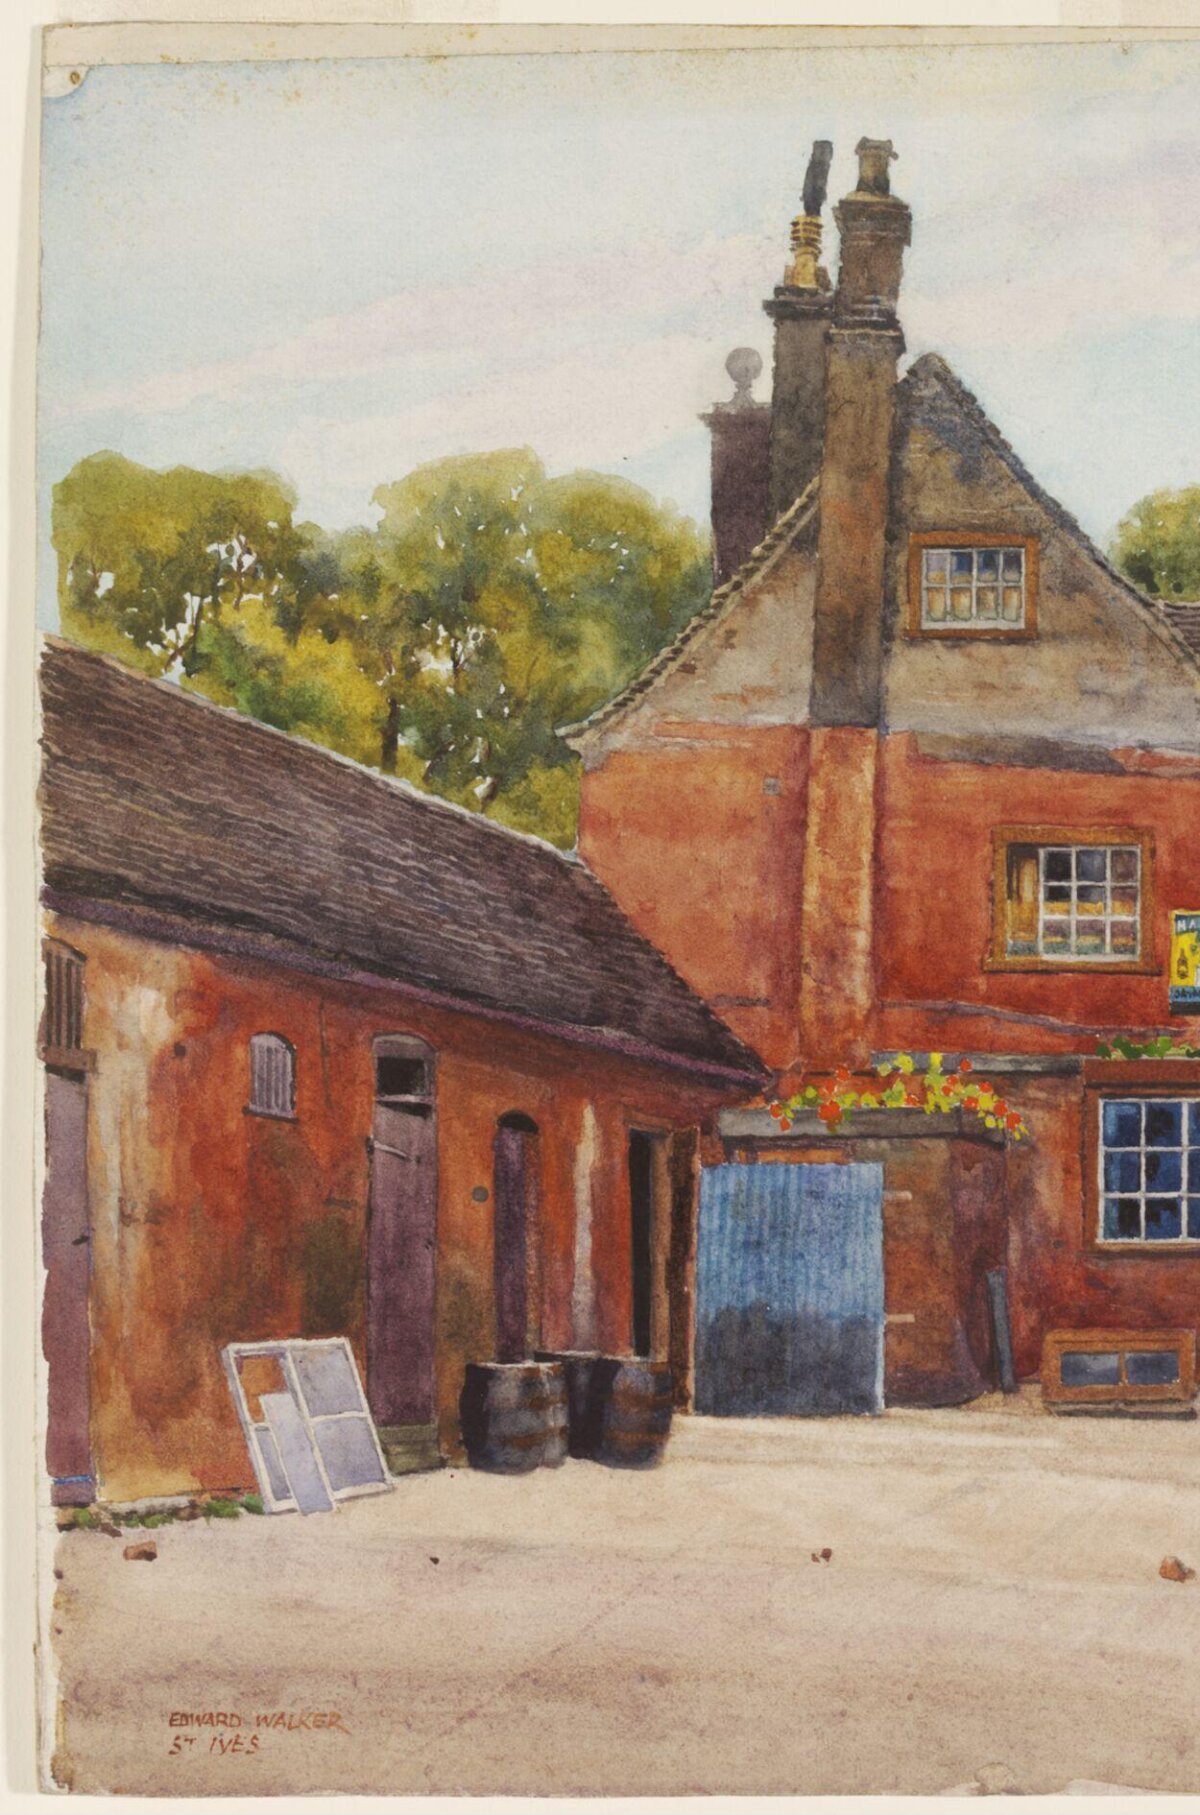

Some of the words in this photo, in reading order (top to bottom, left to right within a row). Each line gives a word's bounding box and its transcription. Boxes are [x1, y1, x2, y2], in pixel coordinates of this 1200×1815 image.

[168, 1711, 242, 1728] EDWARD
[255, 1711, 353, 1735] WALKER
[209, 1733, 260, 1755] IVES
